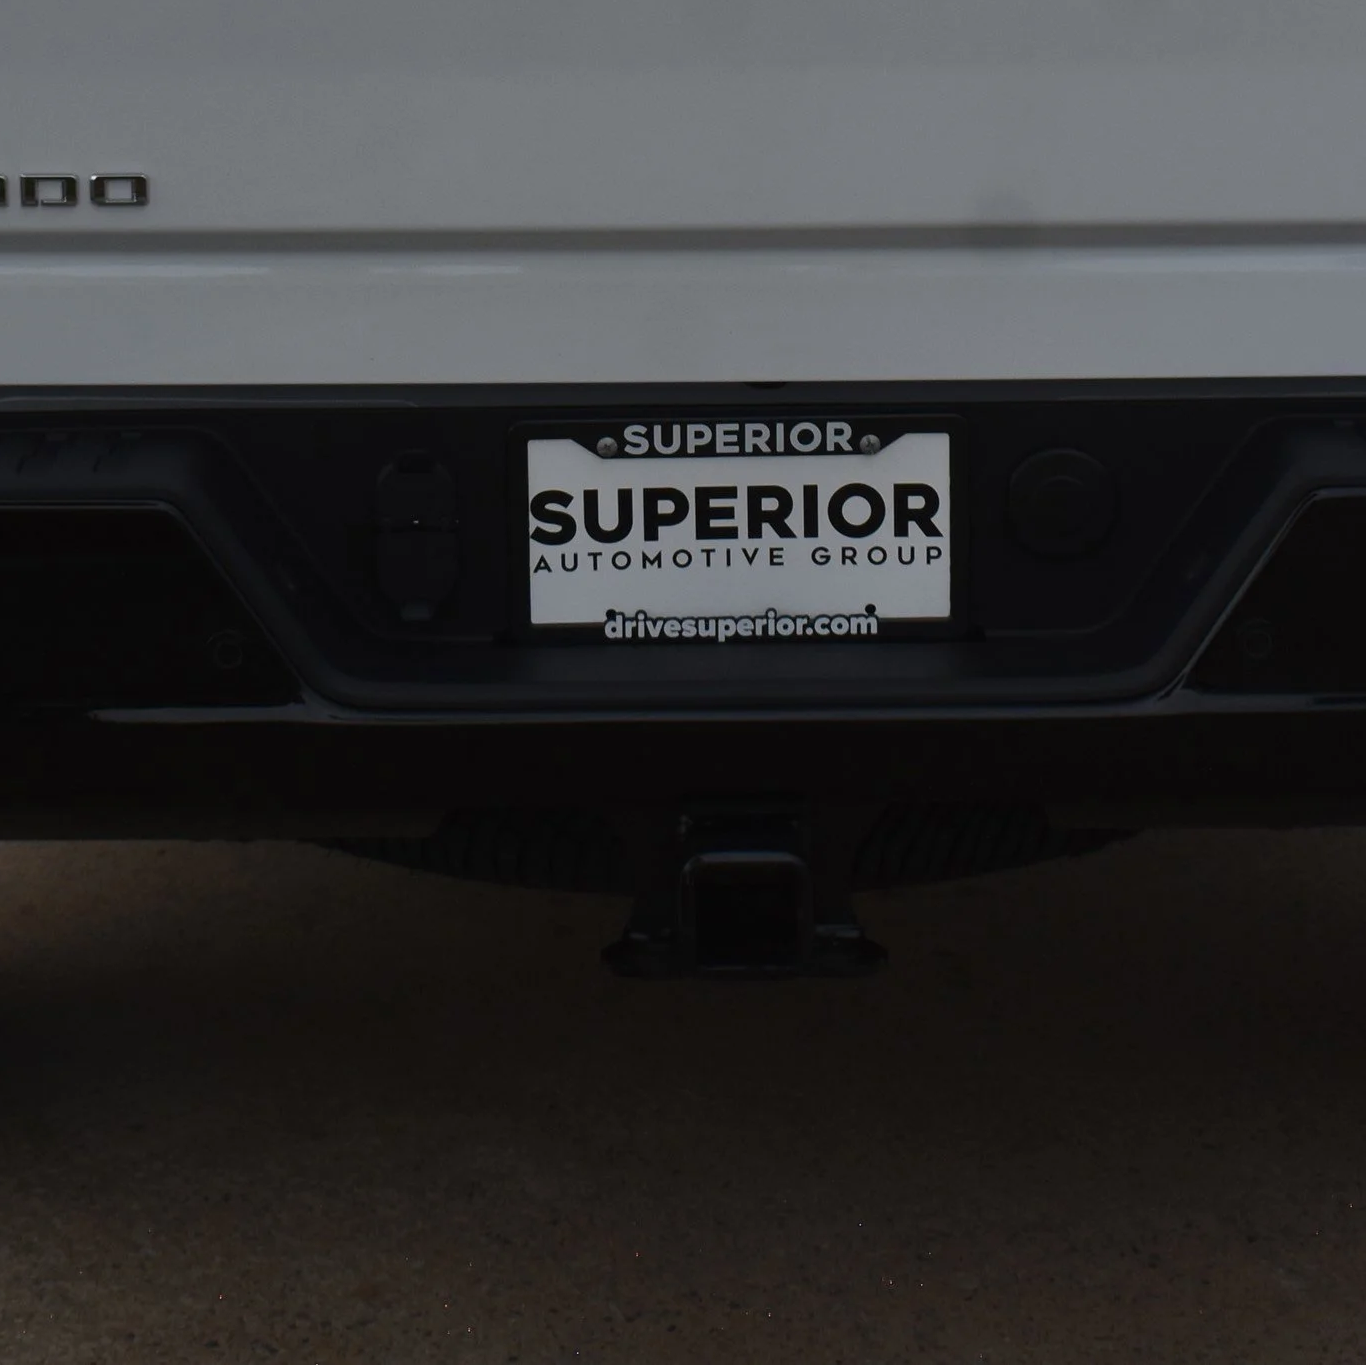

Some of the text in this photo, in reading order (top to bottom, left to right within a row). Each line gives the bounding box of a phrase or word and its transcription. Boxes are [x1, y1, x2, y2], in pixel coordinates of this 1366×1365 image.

[623, 421, 853, 456] SUPERIOR
[529, 482, 944, 546] SUPERIOR
[533, 545, 943, 574] AUTOMOTIVE GROUP
[603, 609, 879, 643] drivesuperior.com
